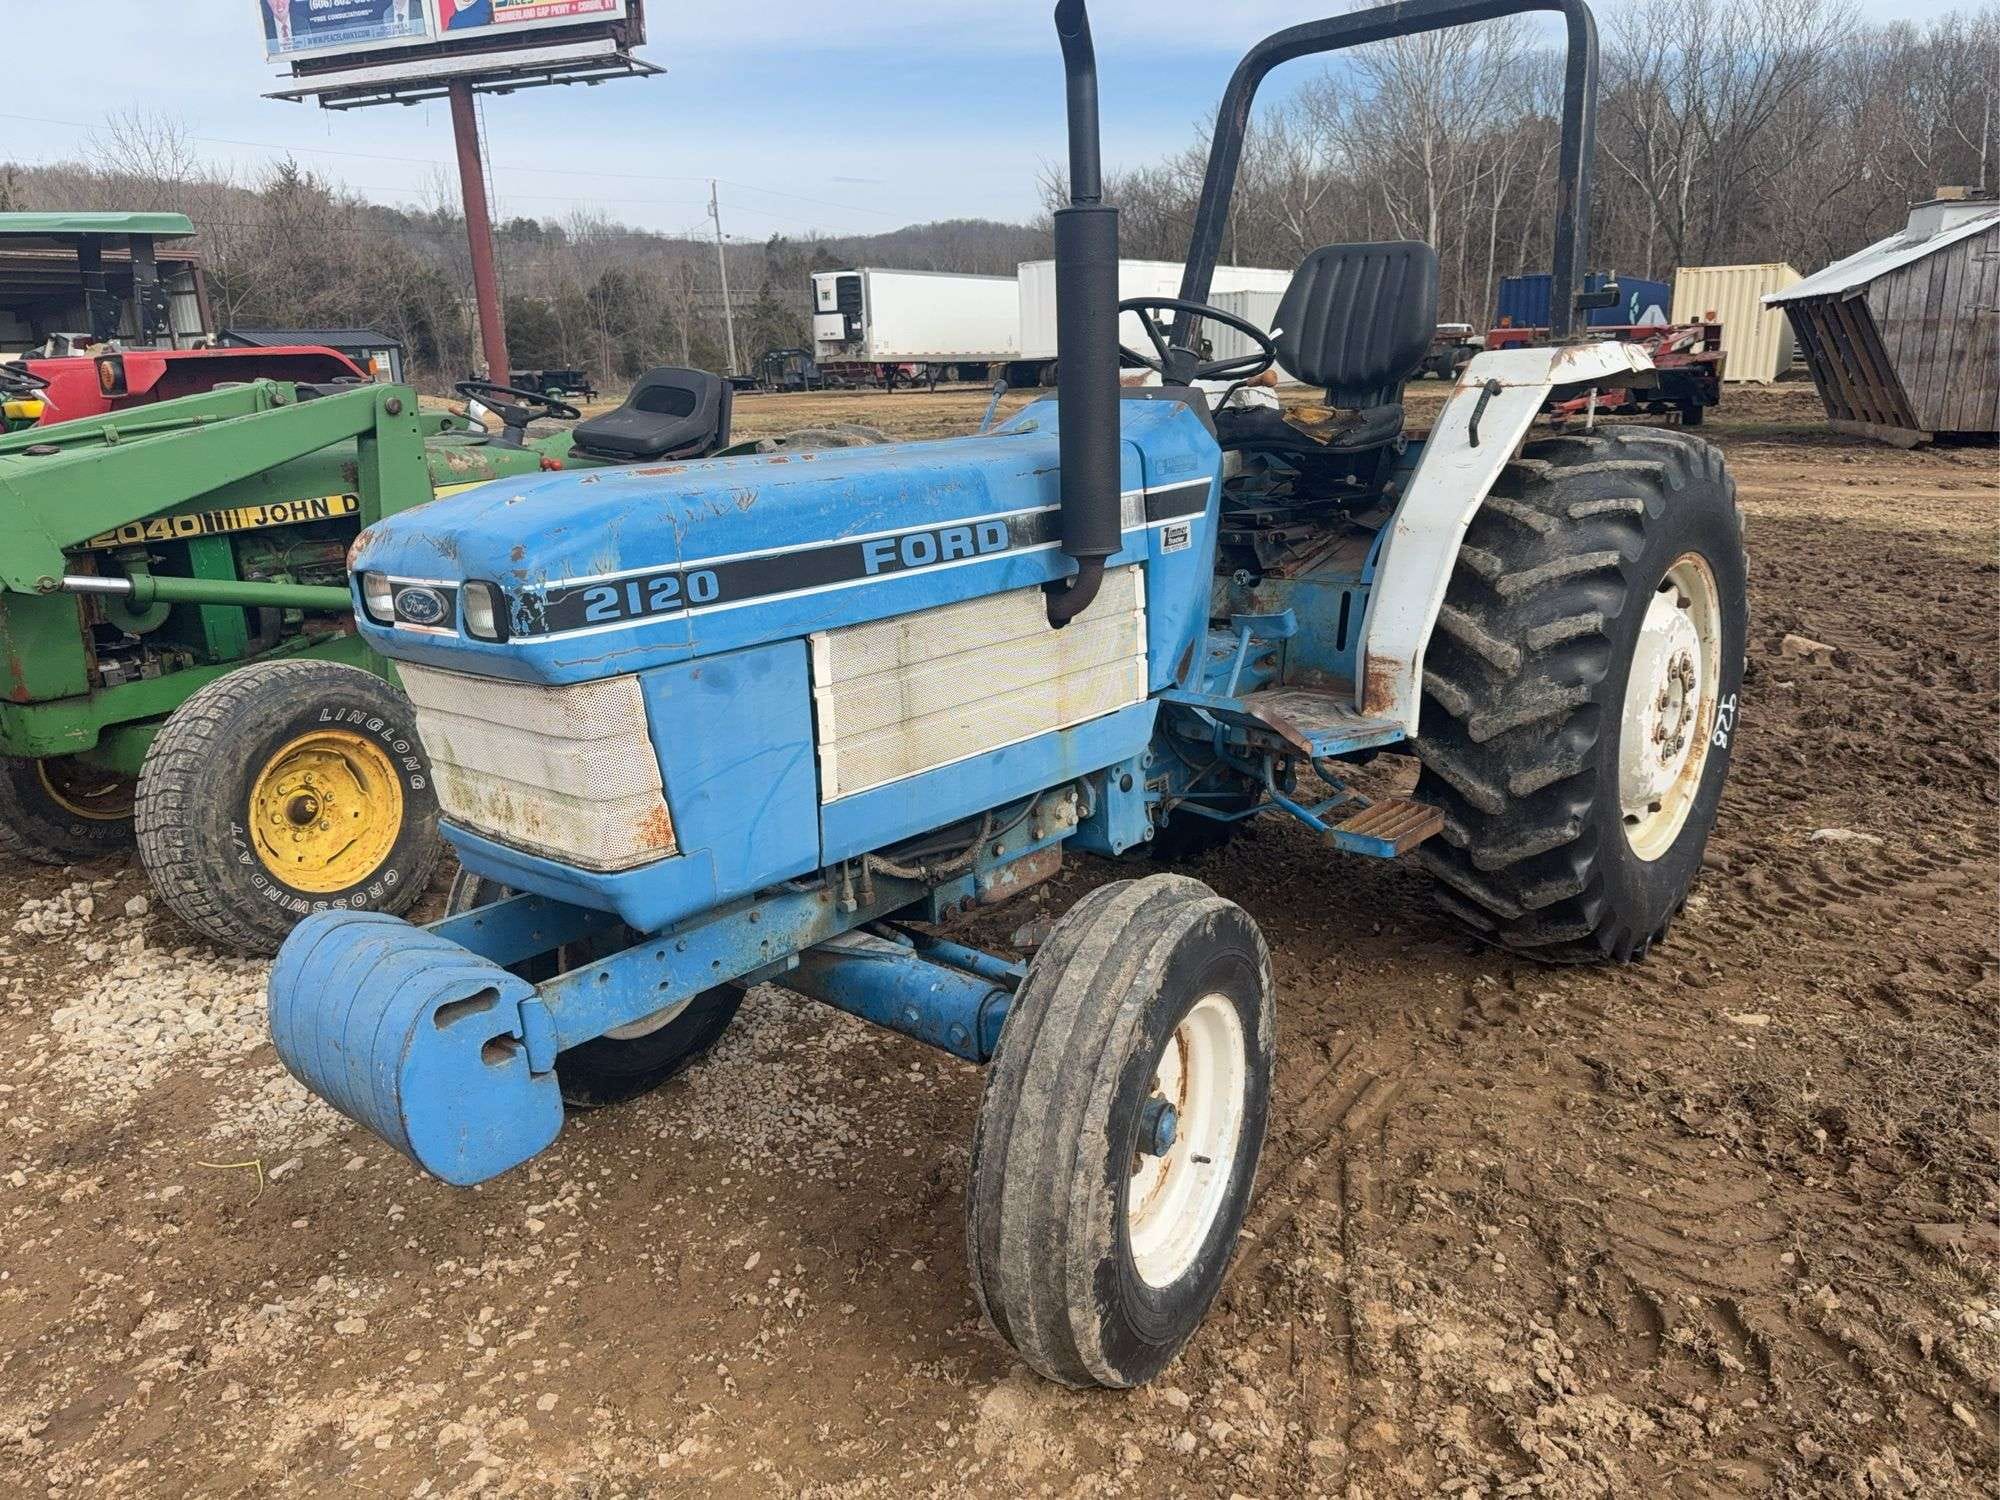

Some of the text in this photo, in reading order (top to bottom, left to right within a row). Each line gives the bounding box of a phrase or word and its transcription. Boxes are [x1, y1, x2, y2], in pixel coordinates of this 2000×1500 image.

[254, 498, 330, 526] JOHN
[862, 519, 1009, 575] FORD
[404, 592, 433, 615] Ford
[583, 570, 720, 622] 2120
[319, 707, 426, 791] LINGLONG
[230, 821, 399, 914] CROSSWIND A/T
